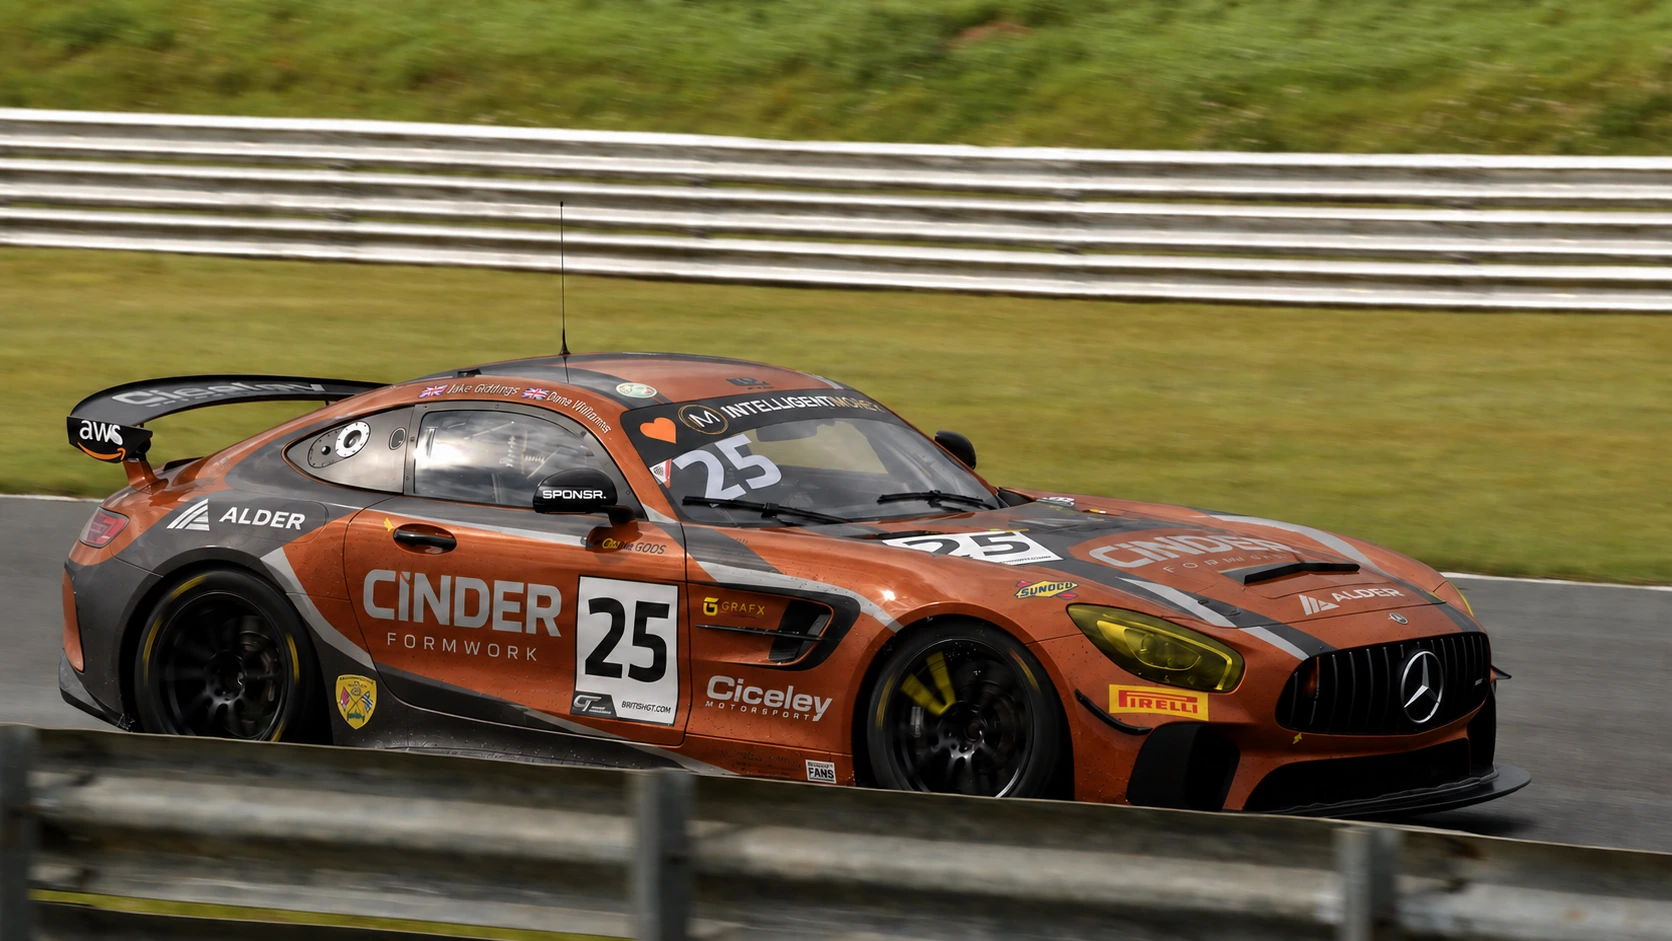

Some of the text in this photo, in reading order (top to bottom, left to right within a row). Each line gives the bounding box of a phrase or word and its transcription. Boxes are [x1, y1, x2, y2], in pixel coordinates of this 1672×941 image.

[79, 420, 124, 446] aws
[672, 434, 782, 508] 25
[542, 489, 607, 500] SPONSR.
[219, 506, 306, 530] ALDER
[903, 532, 1031, 557] 25
[1020, 581, 1074, 598] SUNOCO
[1331, 587, 1405, 602] ALDER
[721, 601, 765, 615] GRAFX
[387, 632, 537, 661] FORMWORK
[584, 597, 670, 683] 25
[621, 700, 672, 713] BRITISHGT.COM
[705, 700, 811, 721] MOTORSPORT
[707, 675, 833, 722] Ciceley
[1118, 690, 1198, 714] PIRELLI
[808, 768, 834, 779] FANS
